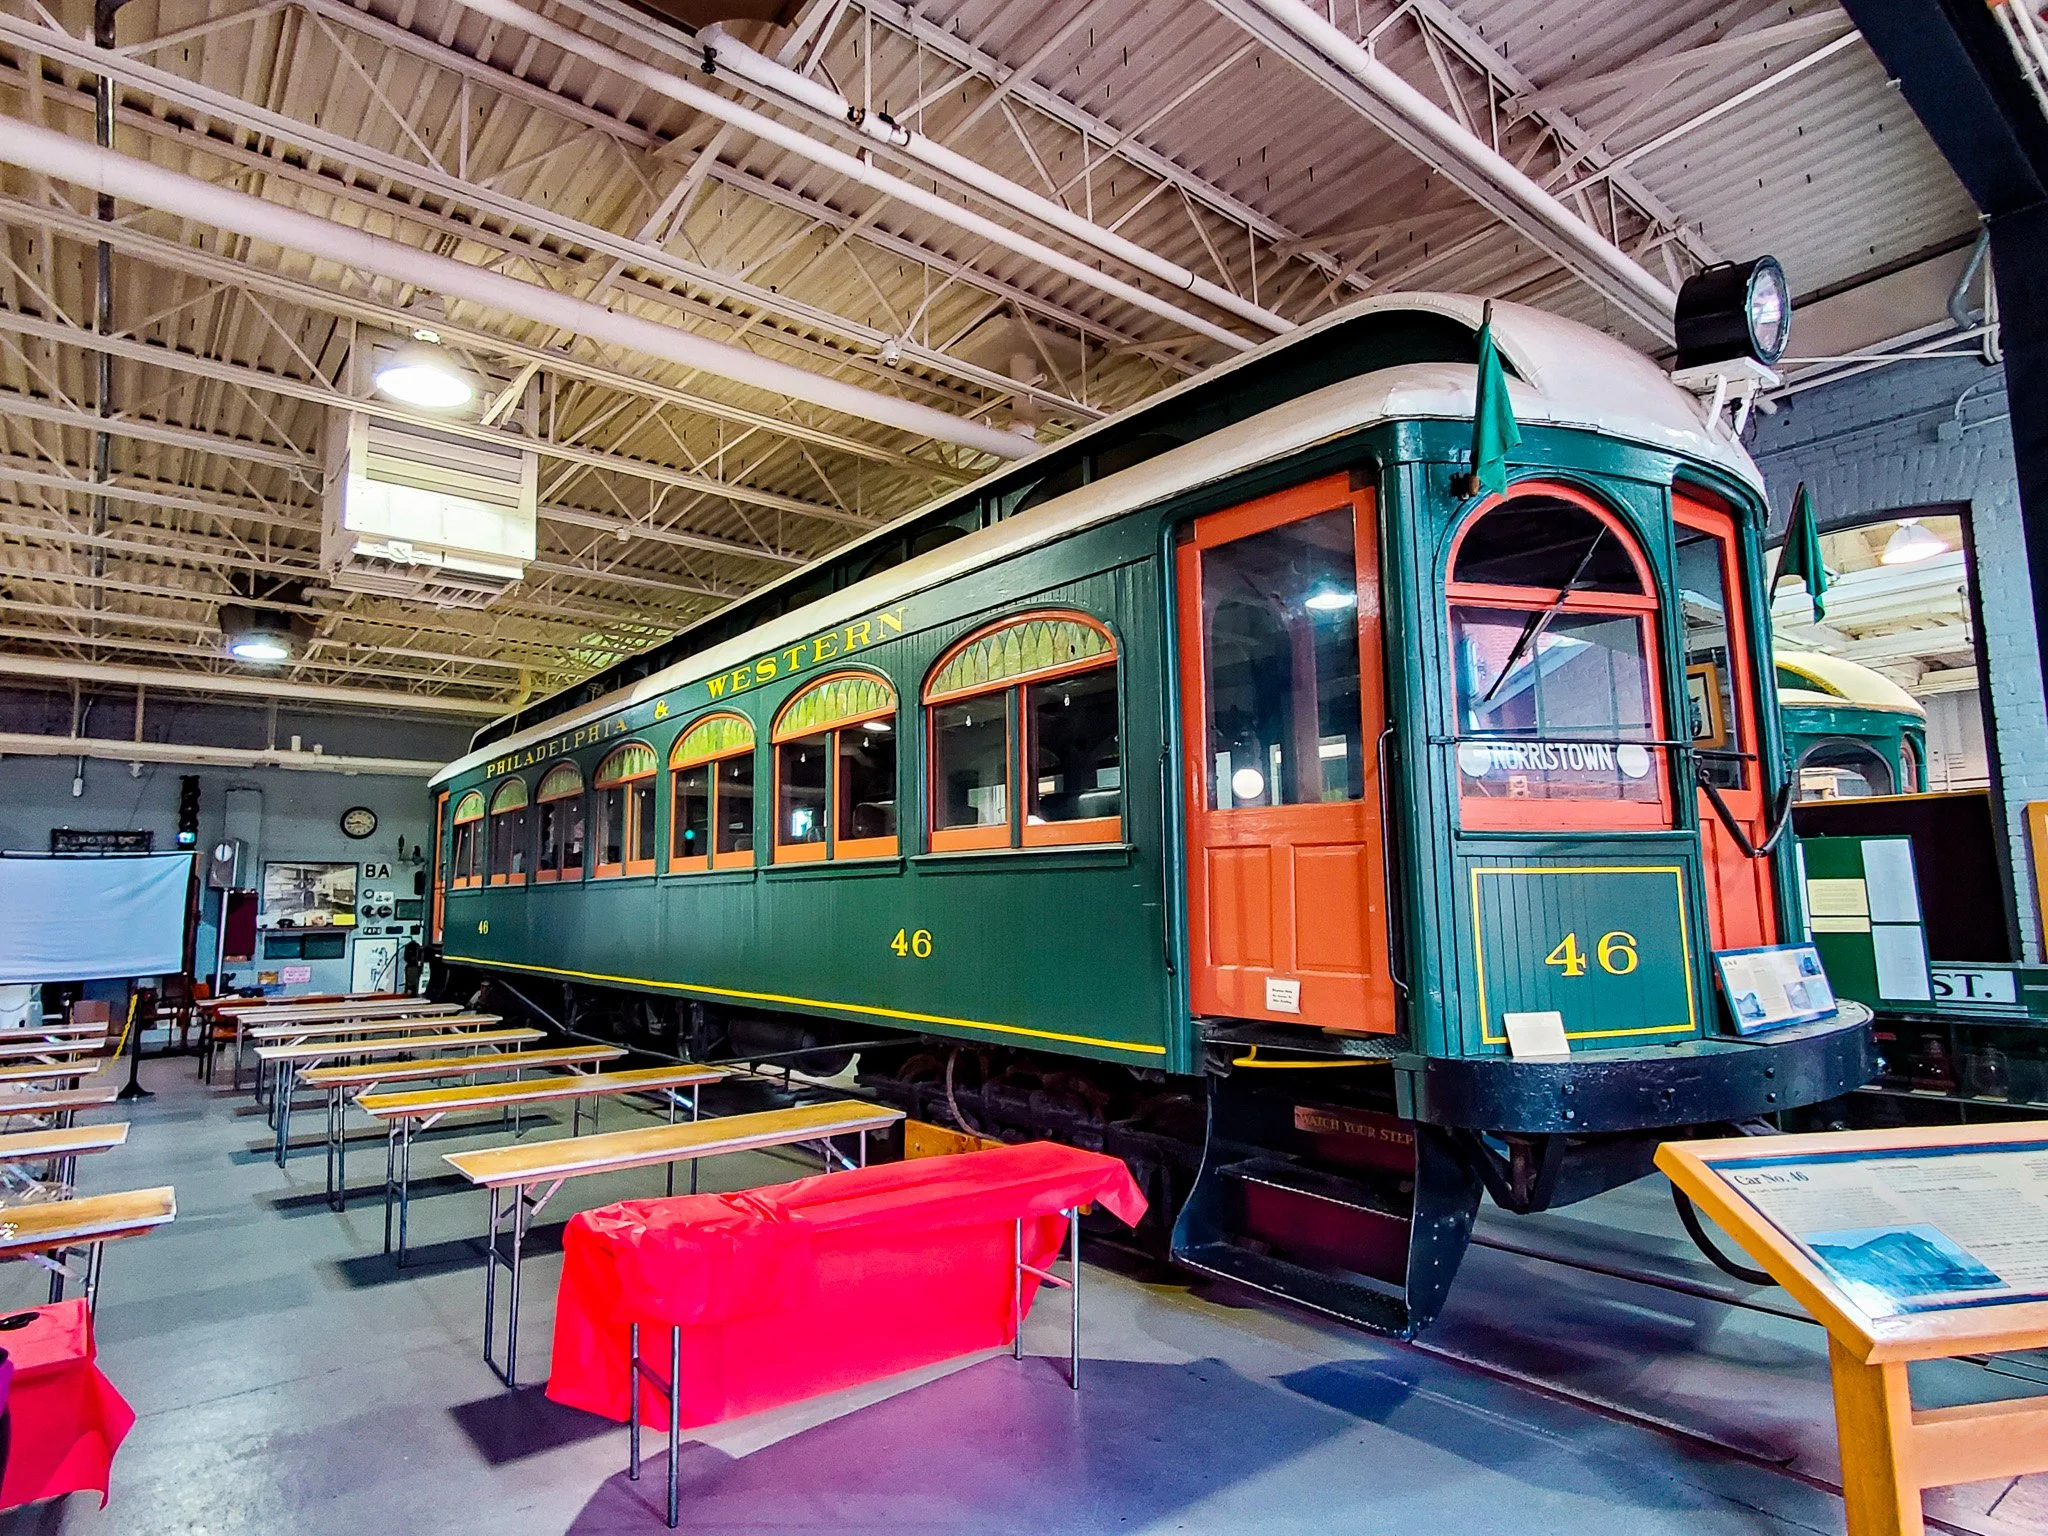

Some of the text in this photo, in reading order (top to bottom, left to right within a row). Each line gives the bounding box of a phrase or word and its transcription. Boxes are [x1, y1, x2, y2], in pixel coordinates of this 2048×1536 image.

[486, 606, 908, 779] PHILADELPHIA & WESTERN
[1492, 742, 1615, 771] NORRISTOWN
[478, 920, 489, 935] 46
[890, 928, 932, 958] 46
[1544, 930, 1639, 977] 46
[1932, 973, 1993, 998] ST.
[1300, 1112, 1414, 1145] WATCH YOUR STEP
[1734, 1171, 1809, 1185] Car No. 46
